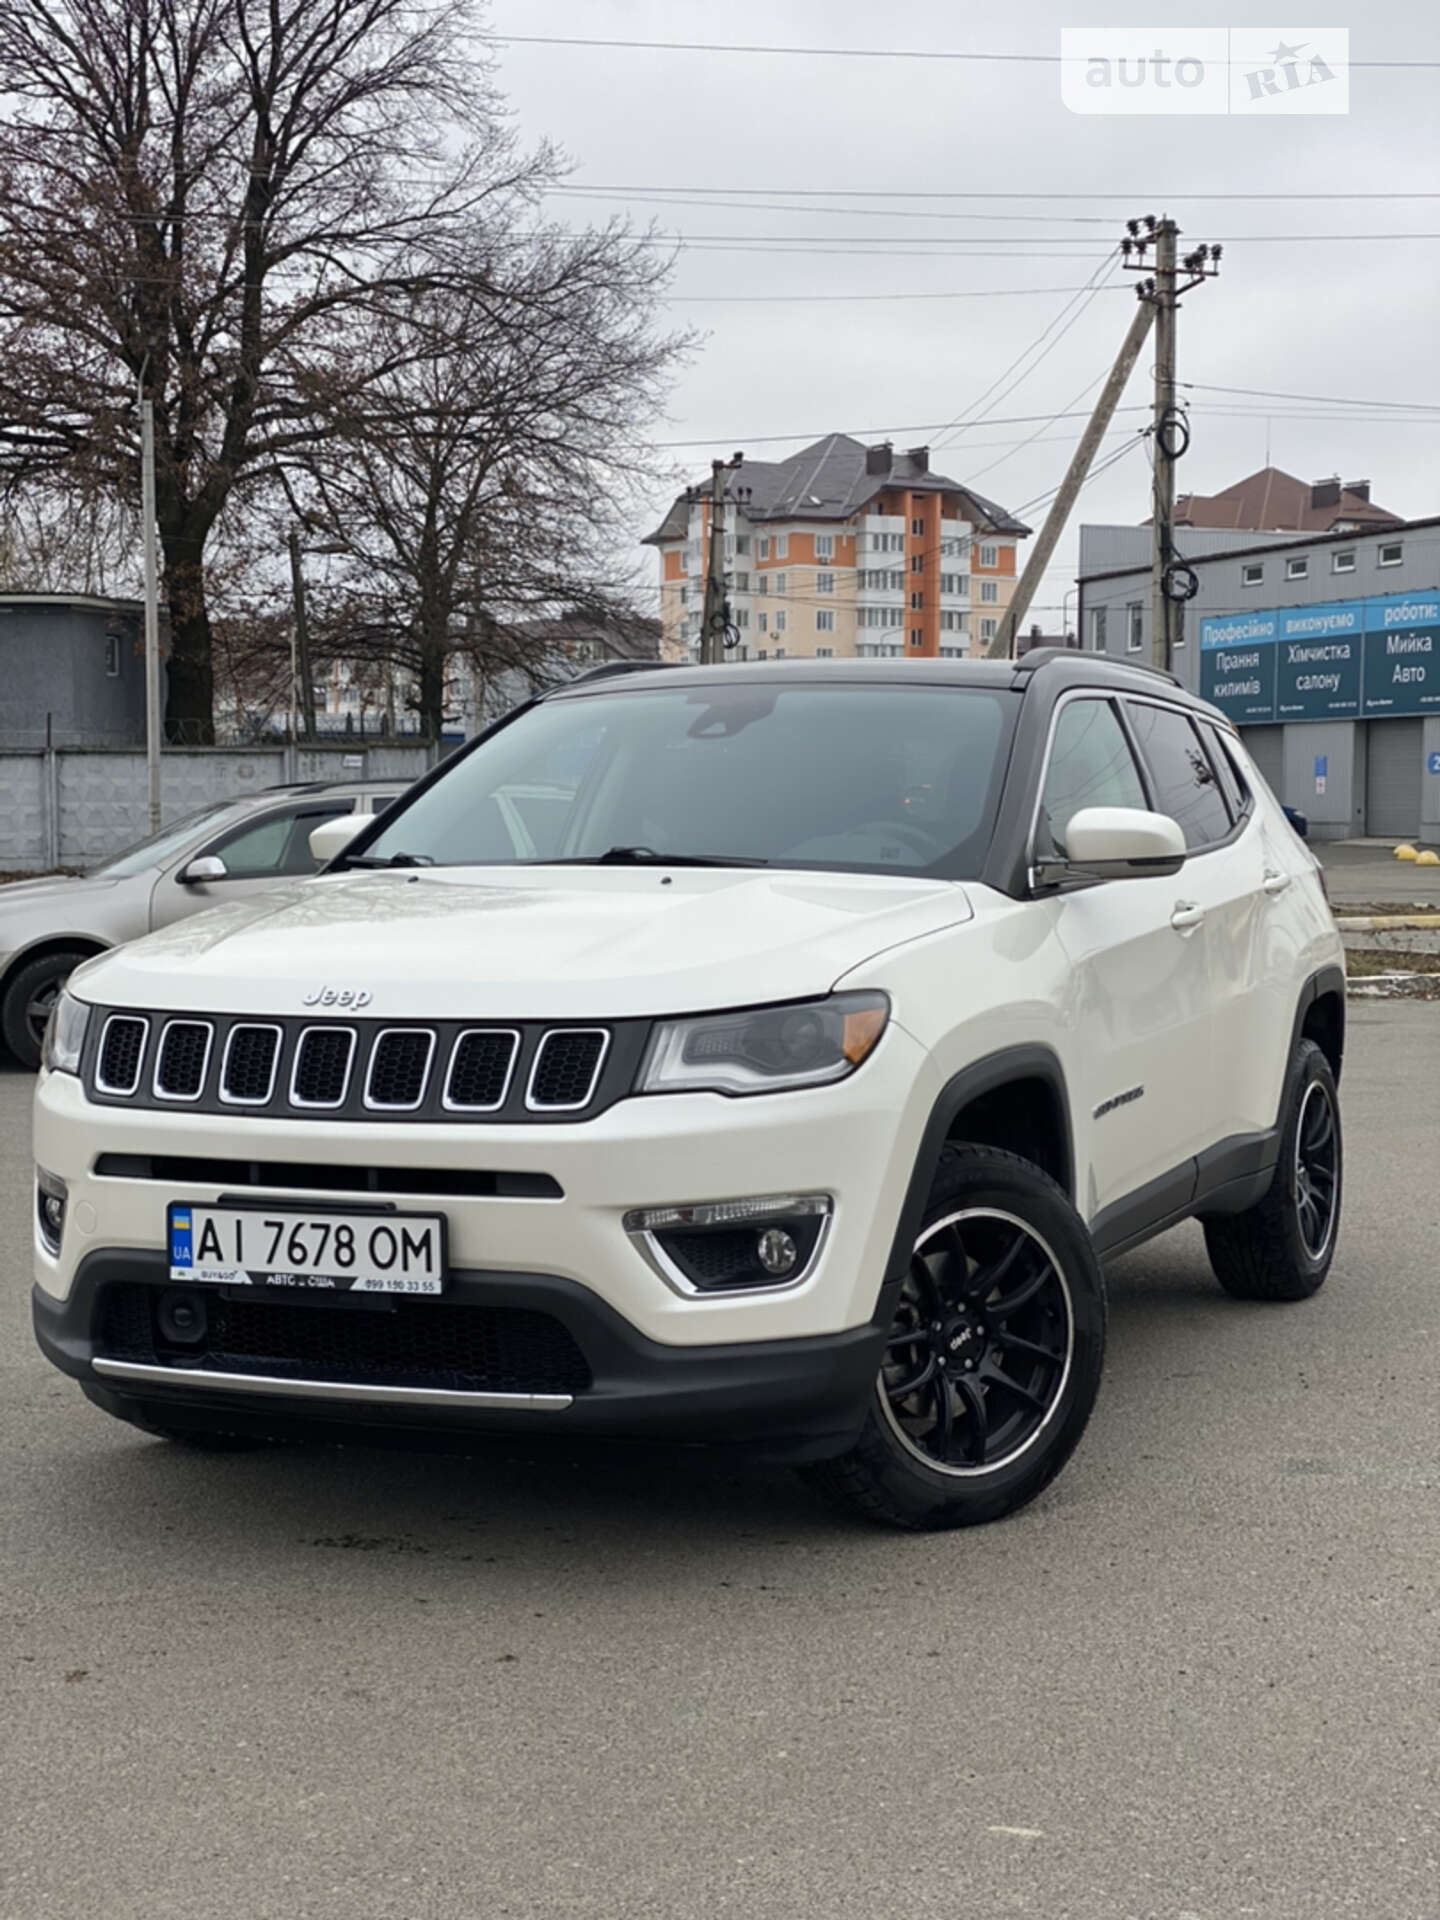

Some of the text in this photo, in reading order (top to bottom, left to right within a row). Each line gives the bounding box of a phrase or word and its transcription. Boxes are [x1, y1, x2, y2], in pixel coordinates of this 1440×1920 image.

[1204, 600, 1438, 646] Професійно виконуємо роботи:
[1288, 644, 1351, 664] Хімчистка
[1386, 633, 1432, 655] Мийка
[1216, 652, 1260, 673] Прання
[1295, 674, 1341, 692] салону
[1392, 664, 1426, 683] Авто
[1213, 676, 1261, 697] килимів
[303, 985, 373, 1011] Jeep
[173, 1246, 191, 1260] UA
[197, 1217, 433, 1273] AI 7678 OM
